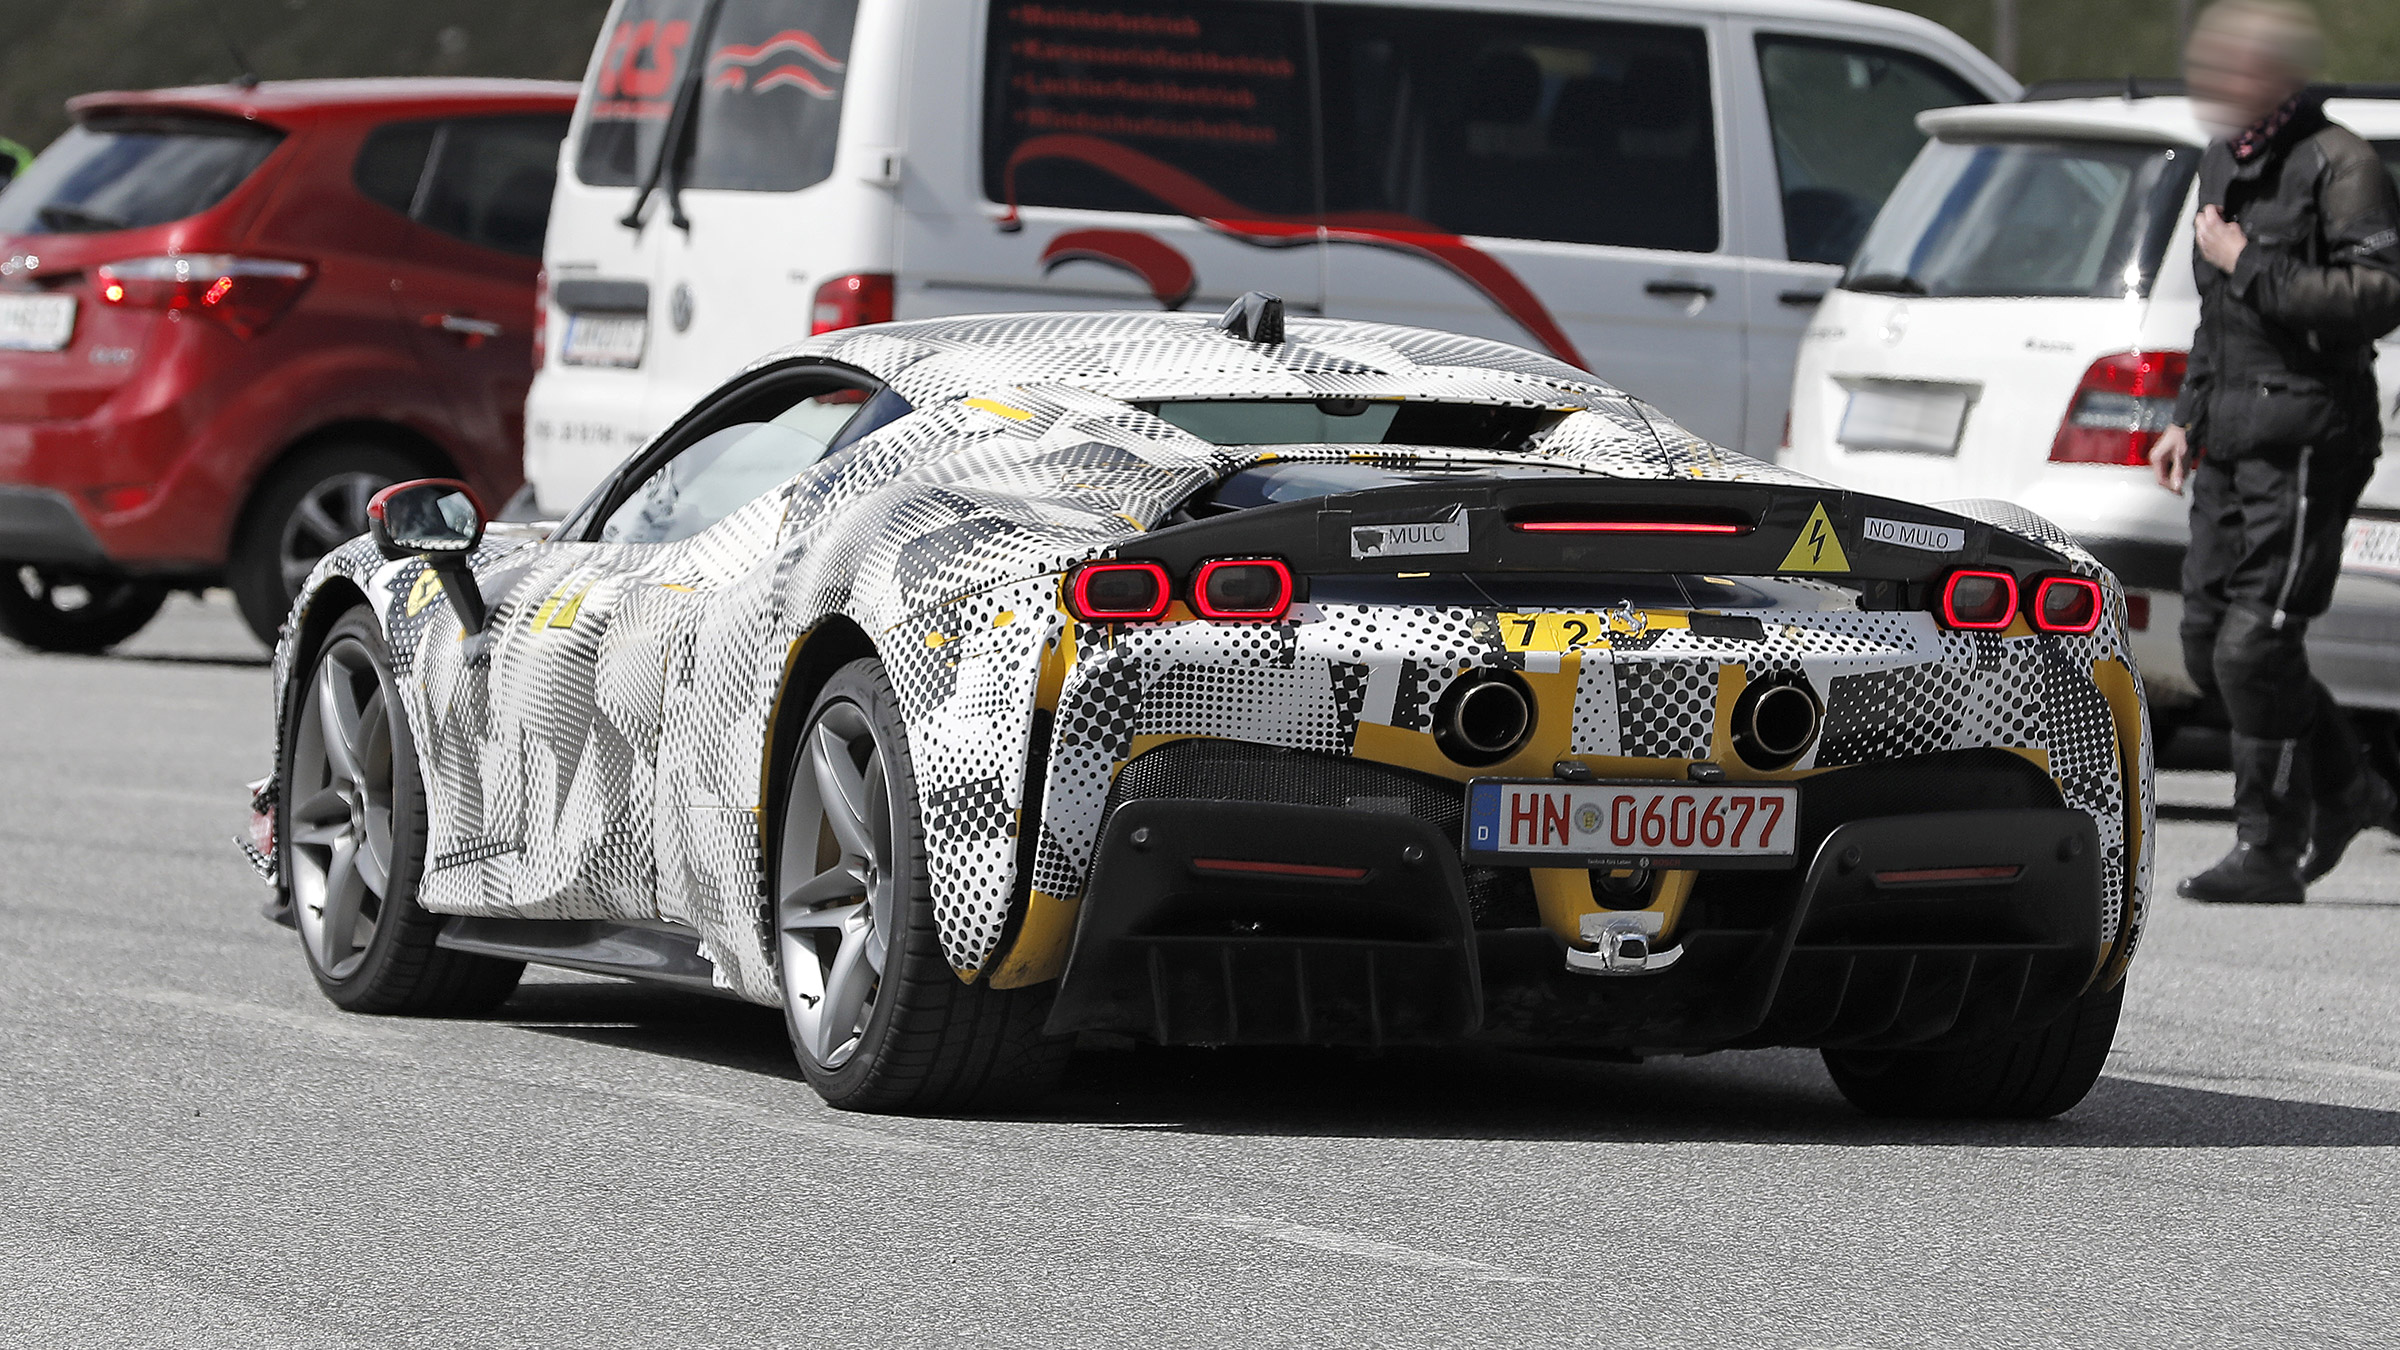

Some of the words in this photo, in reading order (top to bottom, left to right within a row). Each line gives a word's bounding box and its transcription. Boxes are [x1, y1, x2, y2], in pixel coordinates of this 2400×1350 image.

[1868, 520, 1895, 540] NO
[1899, 525, 1949, 549] MULO
[1477, 825, 1489, 841] D
[1510, 793, 1571, 846] HN
[1610, 794, 1784, 848] 060677
